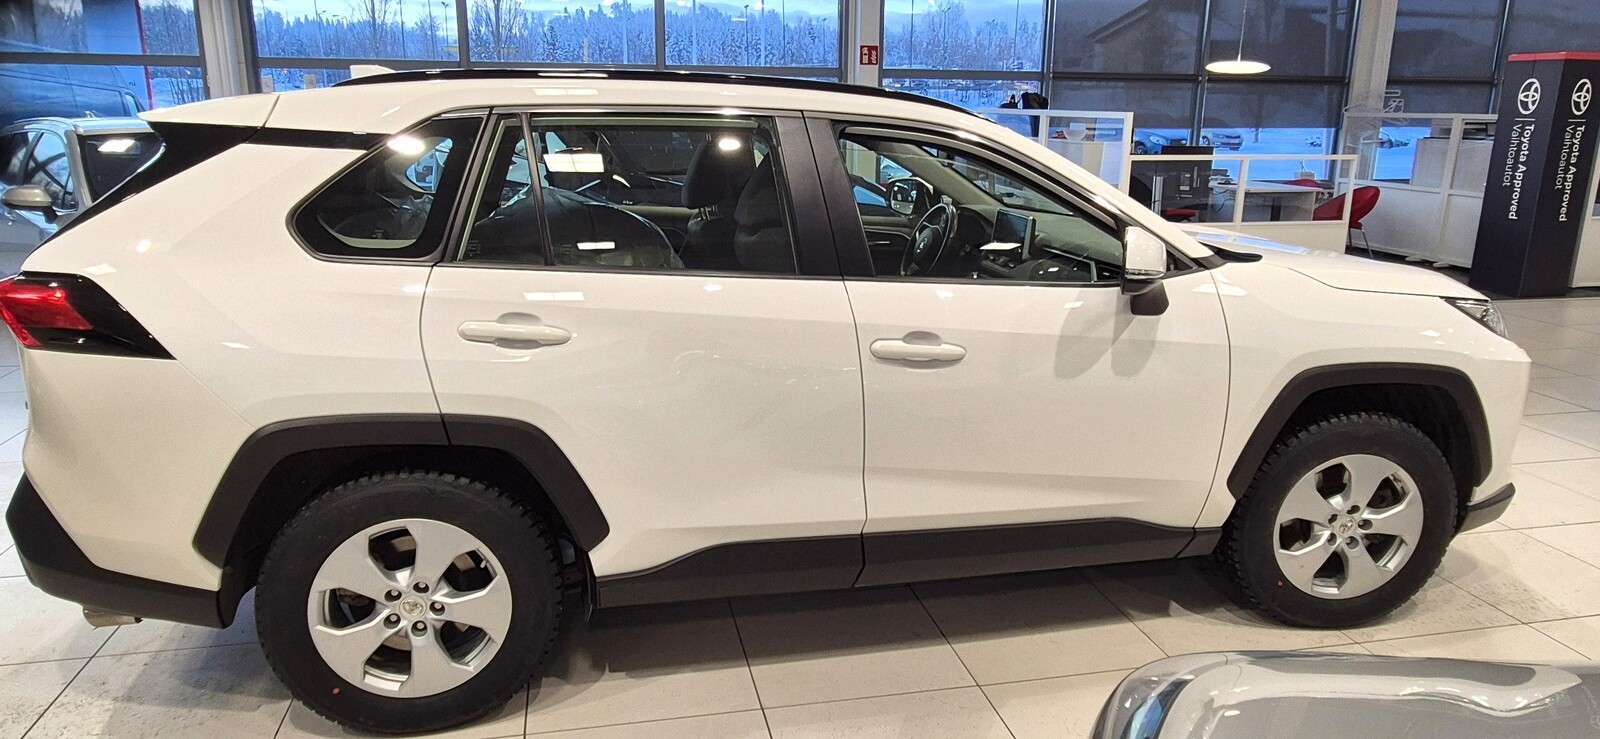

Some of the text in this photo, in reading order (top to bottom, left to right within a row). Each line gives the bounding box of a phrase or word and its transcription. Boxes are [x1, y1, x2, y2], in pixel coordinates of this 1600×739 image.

[1502, 123, 1523, 187] Vaihtoautot
[1508, 123, 1535, 220] Toyota Approved
[1558, 124, 1586, 222] Toyota Approved
